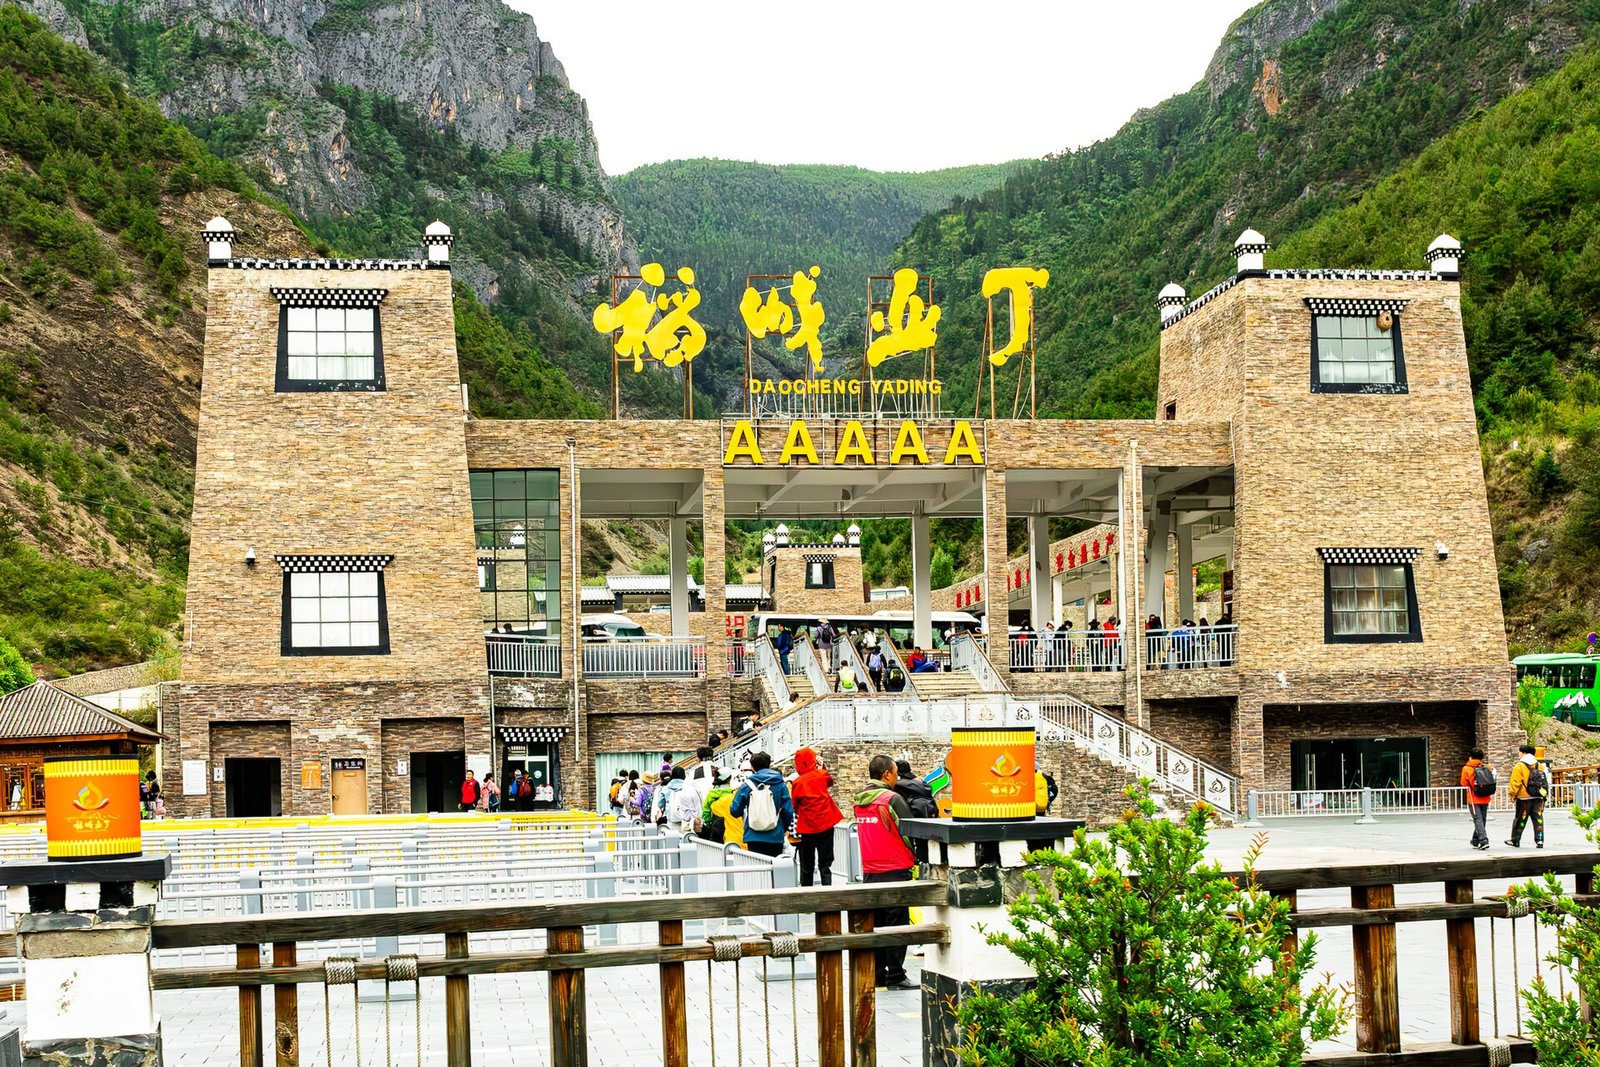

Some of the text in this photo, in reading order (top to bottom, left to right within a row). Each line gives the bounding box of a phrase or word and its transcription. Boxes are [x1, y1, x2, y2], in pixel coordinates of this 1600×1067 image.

[593, 263, 1050, 373] 稻城亚丁
[749, 379, 942, 394] DAOCHENG YADING
